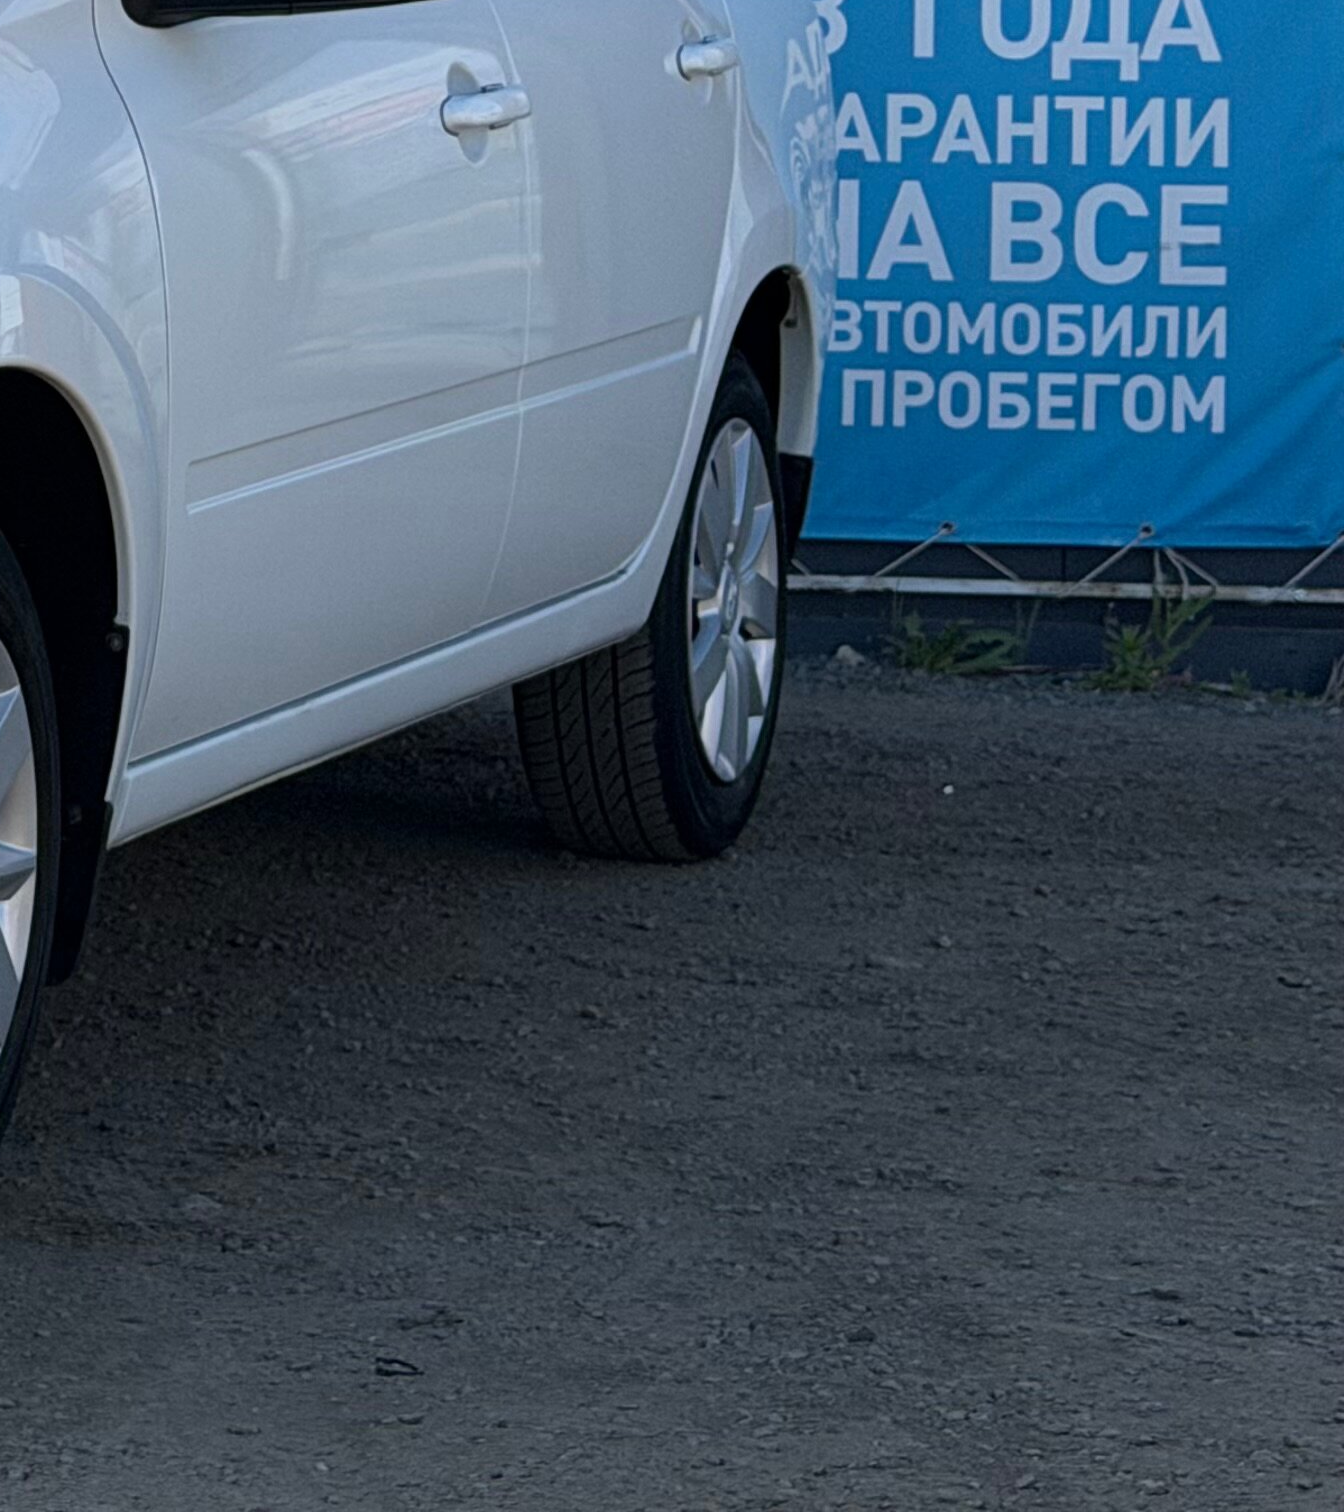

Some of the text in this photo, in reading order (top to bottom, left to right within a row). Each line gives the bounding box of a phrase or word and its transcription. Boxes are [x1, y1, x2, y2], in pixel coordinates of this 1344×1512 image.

[836, 92, 1229, 168] АРАНТИИ
[990, 181, 1229, 286] ВСЕ
[827, 299, 1226, 359] ВТОМОБИЛИ
[841, 368, 1225, 433] ПРОБЕГОМ
